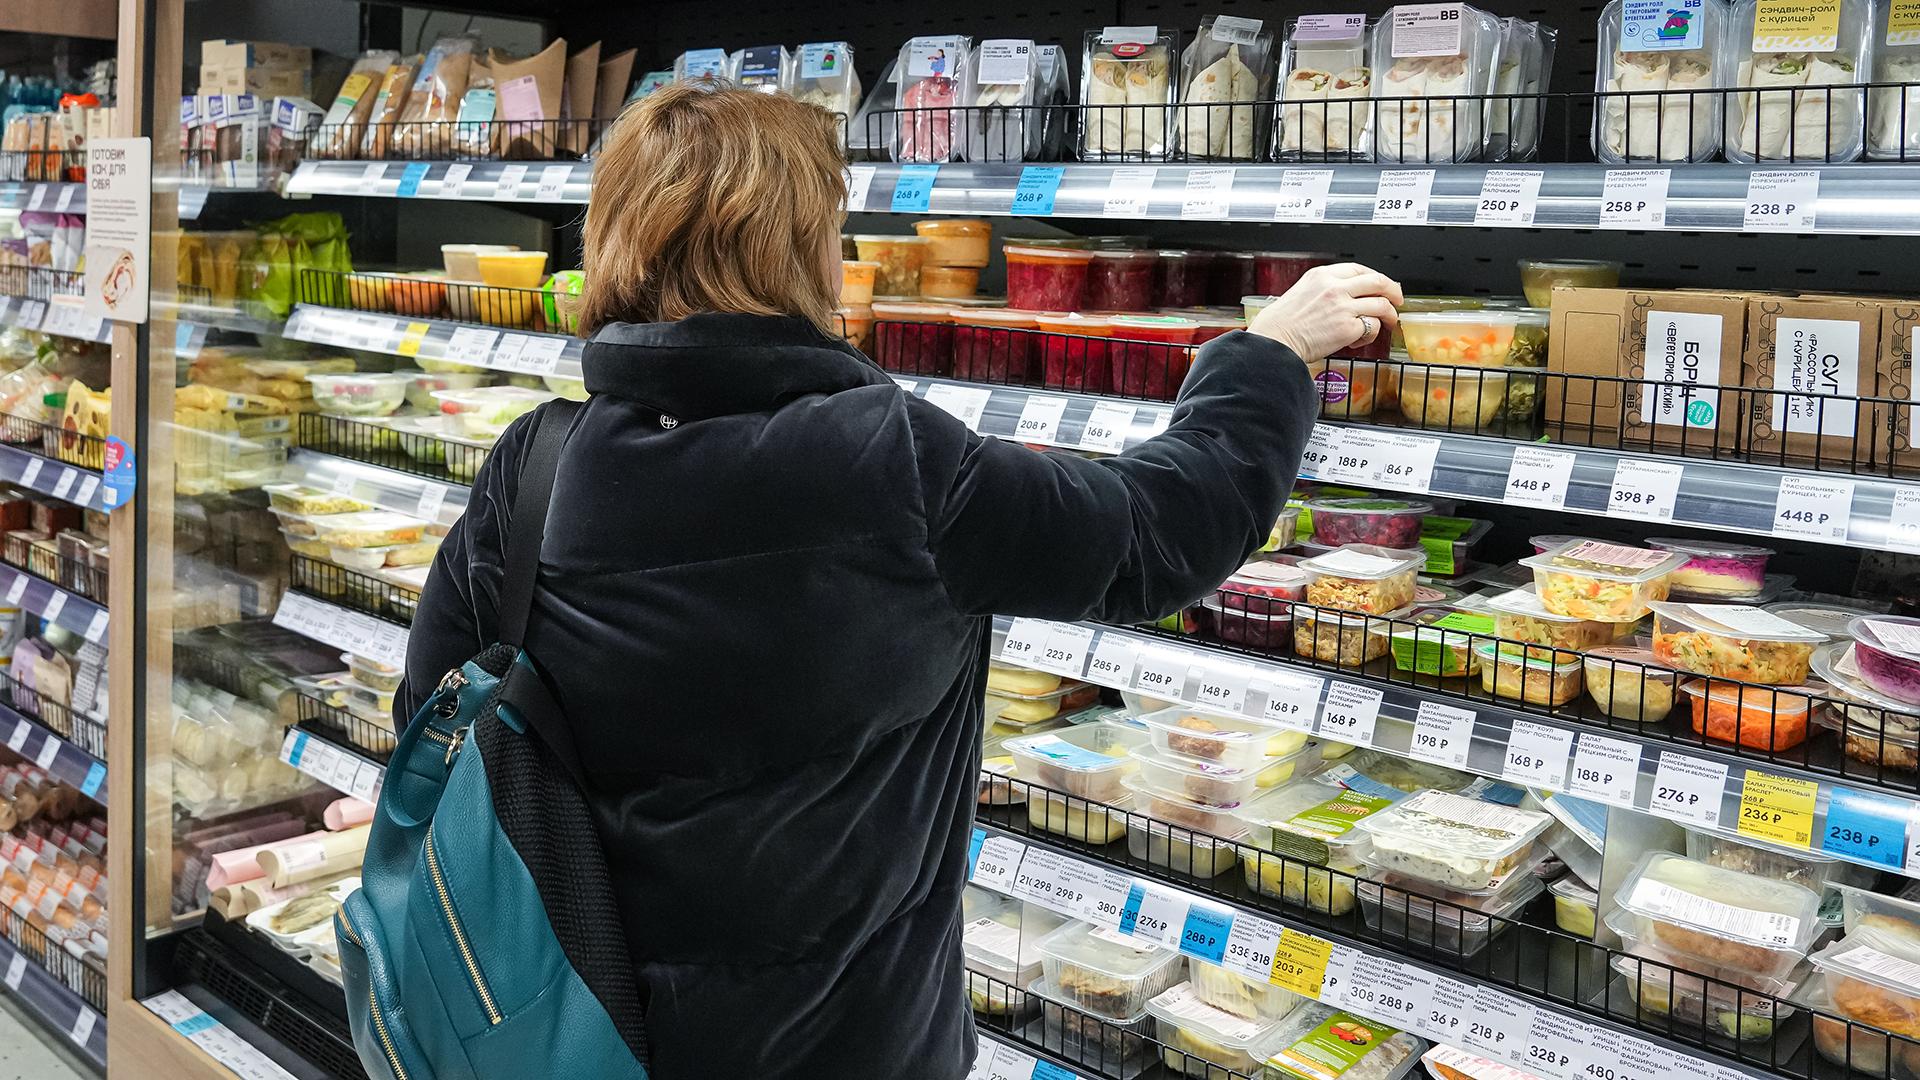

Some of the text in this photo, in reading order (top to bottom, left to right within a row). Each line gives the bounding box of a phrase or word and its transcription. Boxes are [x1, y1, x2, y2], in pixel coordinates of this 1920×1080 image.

[1760, 6, 1836, 14] сэндвич-ролл
[1768, 14, 1815, 24] курицей
[91, 148, 125, 160] ГОТОВИМ
[109, 164, 126, 176] ДЛЯ
[896, 190, 912, 199] 268
[1016, 193, 1034, 202] 268
[1379, 200, 1401, 210] 238
[1482, 200, 1506, 210] 250
[1606, 202, 1632, 212] 258
[1751, 204, 1780, 215] 238
[1678, 342, 1699, 398] БОРЩ
[1021, 420, 1039, 430] 208
[1088, 426, 1103, 437] 168
[1338, 456, 1357, 468] 188
[1512, 479, 1538, 490] 448
[1615, 491, 1641, 503] 398
[1780, 510, 1813, 523] 448
[1007, 640, 1022, 650] 218
[1046, 649, 1064, 660] 223
[1093, 659, 1111, 671] 285
[1143, 671, 1162, 683] 208
[1202, 684, 1221, 697] 148
[1336, 690, 1376, 701] ЧЕРНОСЛИВОМ
[1358, 687, 1380, 697] СВЕКЛЫ
[1270, 700, 1288, 713] 168
[1328, 700, 1353, 710] ОРЕХАМИ
[1327, 712, 1345, 725] 168
[1418, 714, 1452, 726] ЛИМОННОЙ
[1417, 721, 1450, 731] ЗАПРАВКОЙ
[1417, 734, 1436, 747] 198
[1534, 730, 1563, 742] ПОСТНЫЙ
[1581, 734, 1601, 742] САЛАТ
[1580, 741, 1622, 754] СВЕКОЛЬНЫЙ
[1510, 753, 1531, 767] 168
[1578, 747, 1634, 763] ГРЕЦКИМ ОРЕХОМ
[1662, 752, 1682, 760] САЛАТ
[1660, 764, 1720, 780] ТУНЦОМ ЯБЛОКОМ
[1661, 758, 1724, 775] КОНСЕРВИРОВАННЫМ
[1577, 768, 1600, 782] 188
[1746, 780, 1766, 788] САЛАТ
[1658, 787, 1684, 802] 276
[1744, 808, 1768, 821] 236
[1831, 826, 1862, 844] 238
[979, 862, 997, 874] 308
[1034, 880, 1052, 892] 298
[1056, 887, 1074, 900] 298
[1097, 901, 1116, 915] 380
[1140, 915, 1158, 929] 276
[1185, 930, 1205, 944] 288
[1252, 952, 1270, 966] 318
[1276, 960, 1294, 973] 203
[1385, 961, 1402, 970] ПЕРЕЦ
[1350, 979, 1370, 988] СЫРОМ
[1380, 980, 1404, 990] КУРИЦЫ
[1392, 977, 1412, 986] МЯСОМ
[1351, 987, 1374, 1002] 308
[1476, 993, 1504, 1007] КАПУСТОЙ
[1478, 987, 1526, 1009] БИТОЧЕК КУРИНЫЙ
[1379, 994, 1402, 1009] 288
[1472, 1004, 1488, 1014] ПЮРЕ
[1474, 999, 1517, 1017] КАРТОФЕЛЬНЫМ
[1533, 1016, 1568, 1032] ГОВЯДИНЫ
[1535, 1010, 1583, 1031] БЕФСТРОГАНОВ
[1470, 1022, 1492, 1039] 218
[1530, 1030, 1548, 1040] ПЮРЕ
[1532, 1024, 1583, 1044] КАРТОФЕЛЬНЫМ
[1623, 1039, 1650, 1051] КОТЛЕТА
[1530, 1046, 1556, 1063] 328
[1622, 1045, 1650, 1058] НА ПАРУ
[1675, 1055, 1705, 1067] ОЛАДЬИ
[1585, 1064, 1614, 1080] 480
[1619, 1060, 1656, 1075] БРОККОЛИ
[1674, 1062, 1709, 1076] КУРИНЫЕ,
